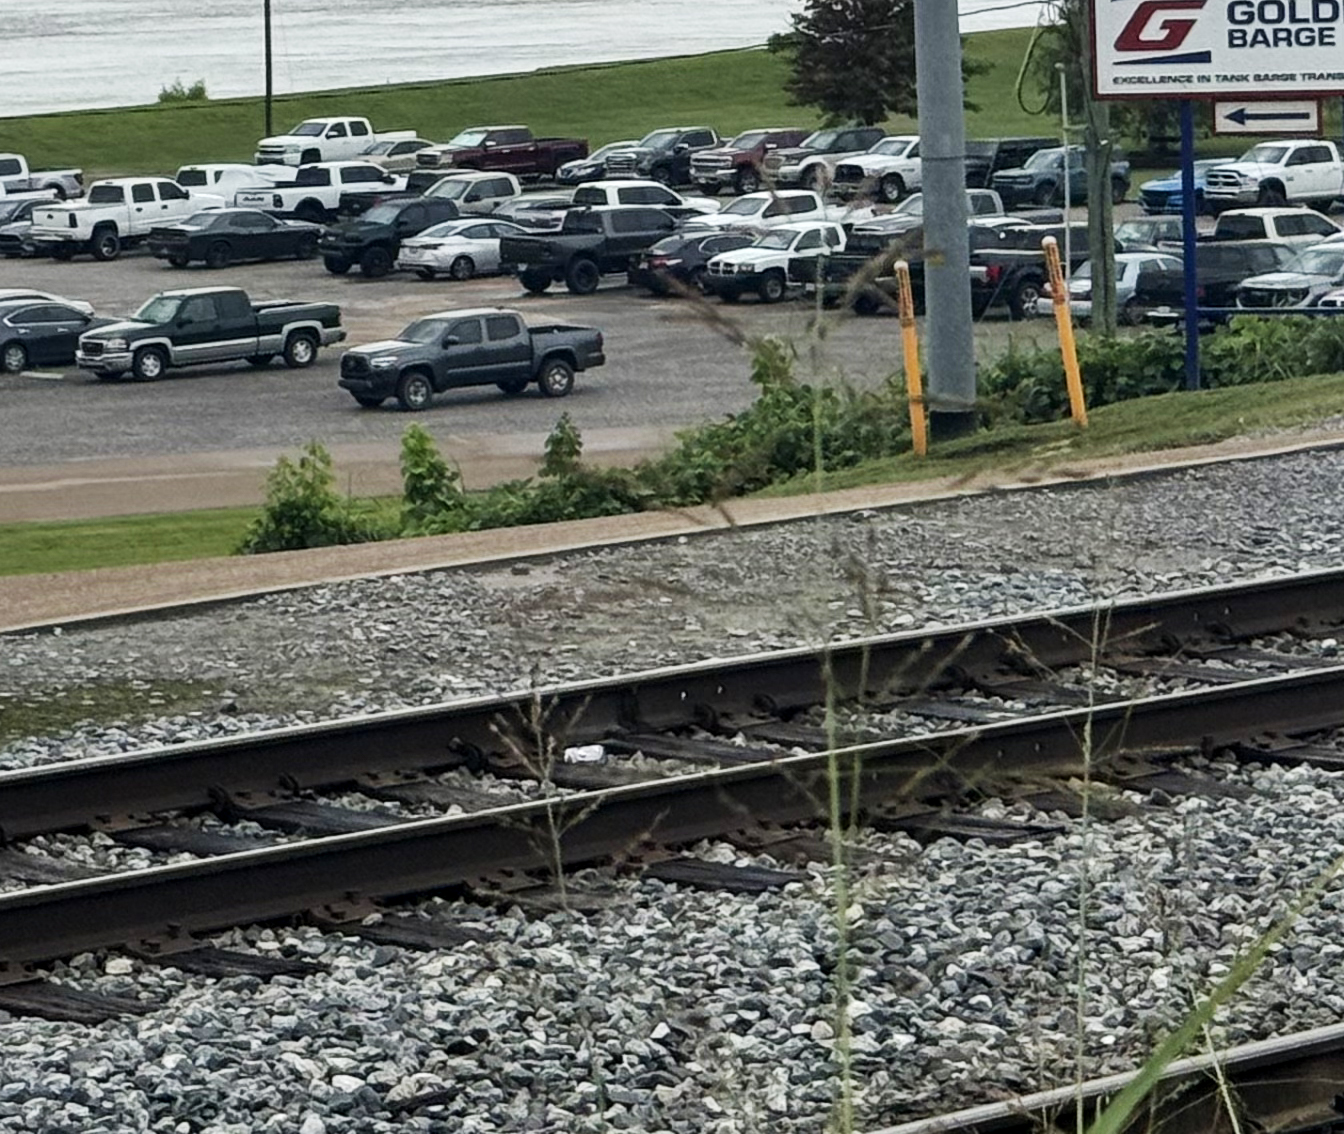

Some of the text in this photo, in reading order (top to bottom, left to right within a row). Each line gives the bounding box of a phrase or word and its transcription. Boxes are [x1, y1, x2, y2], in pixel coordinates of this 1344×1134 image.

[1227, 27, 1336, 48] BARGE
[1112, 75, 1193, 84] EXCELLENCE
[1197, 74, 1211, 83] IN
[1215, 73, 1249, 83] TANK
[1253, 73, 1297, 82] BARGE
